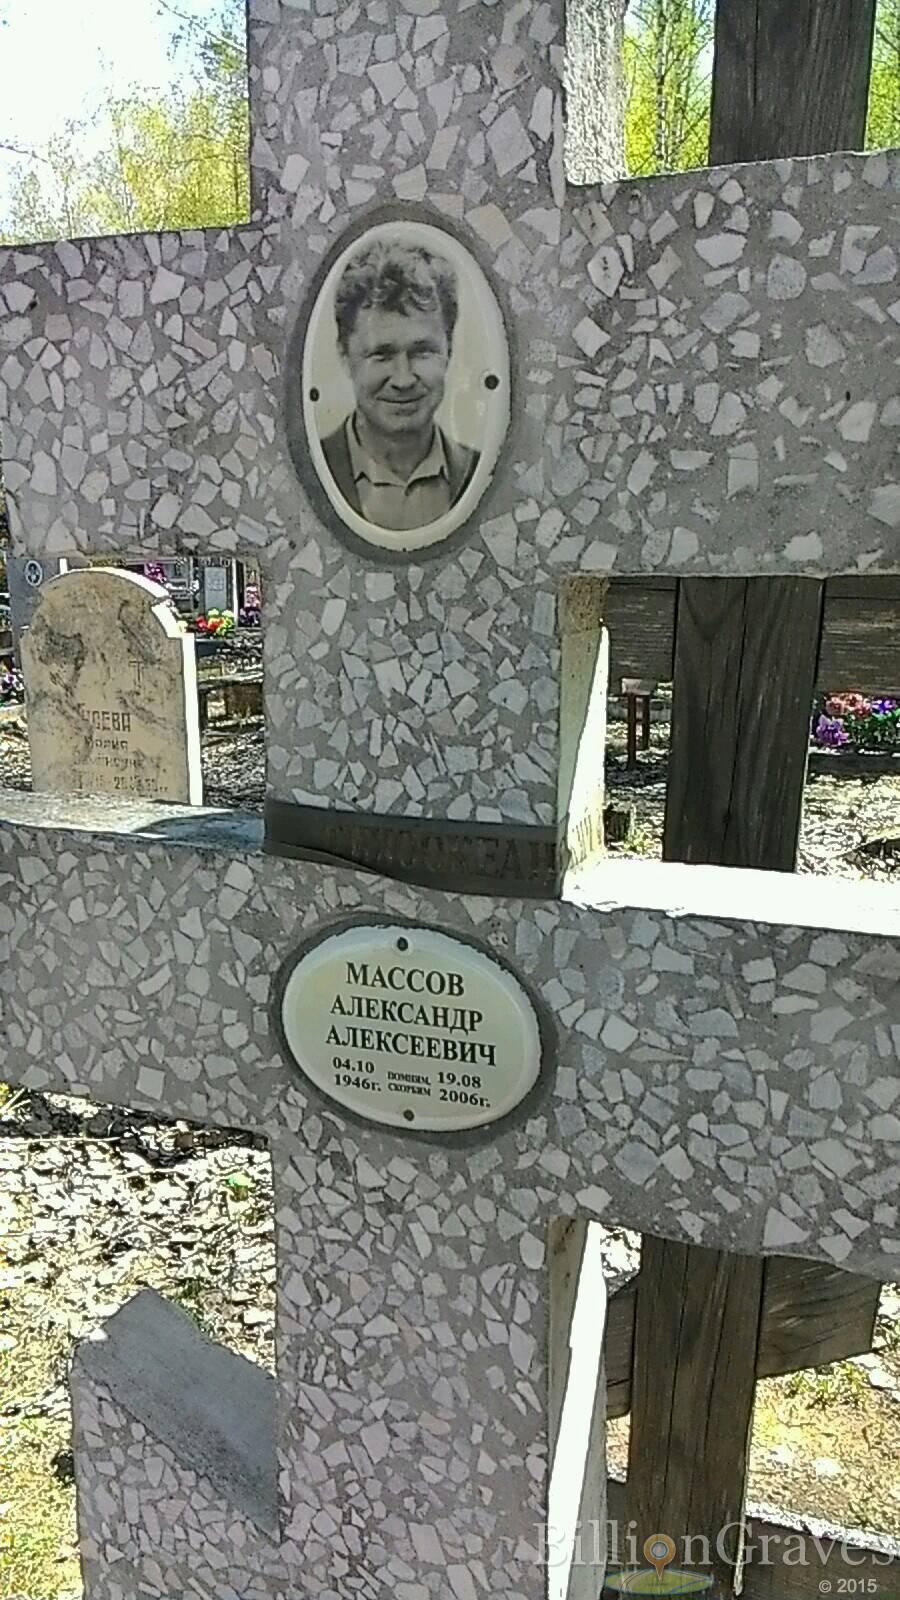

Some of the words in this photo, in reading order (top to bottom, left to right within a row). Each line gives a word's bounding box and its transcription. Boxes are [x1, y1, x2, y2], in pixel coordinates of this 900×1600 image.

[345, 961, 465, 997] МАССОВ
[329, 994, 483, 1035] АЛЕКСАНДР
[325, 1024, 497, 1067] АЛЕКСЕЕВИЧ
[332, 1056, 375, 1074] 04.10
[334, 1073, 382, 1092] 1946г.
[437, 1071, 482, 1089] 19.08
[439, 1088, 491, 1108] 2006г.
